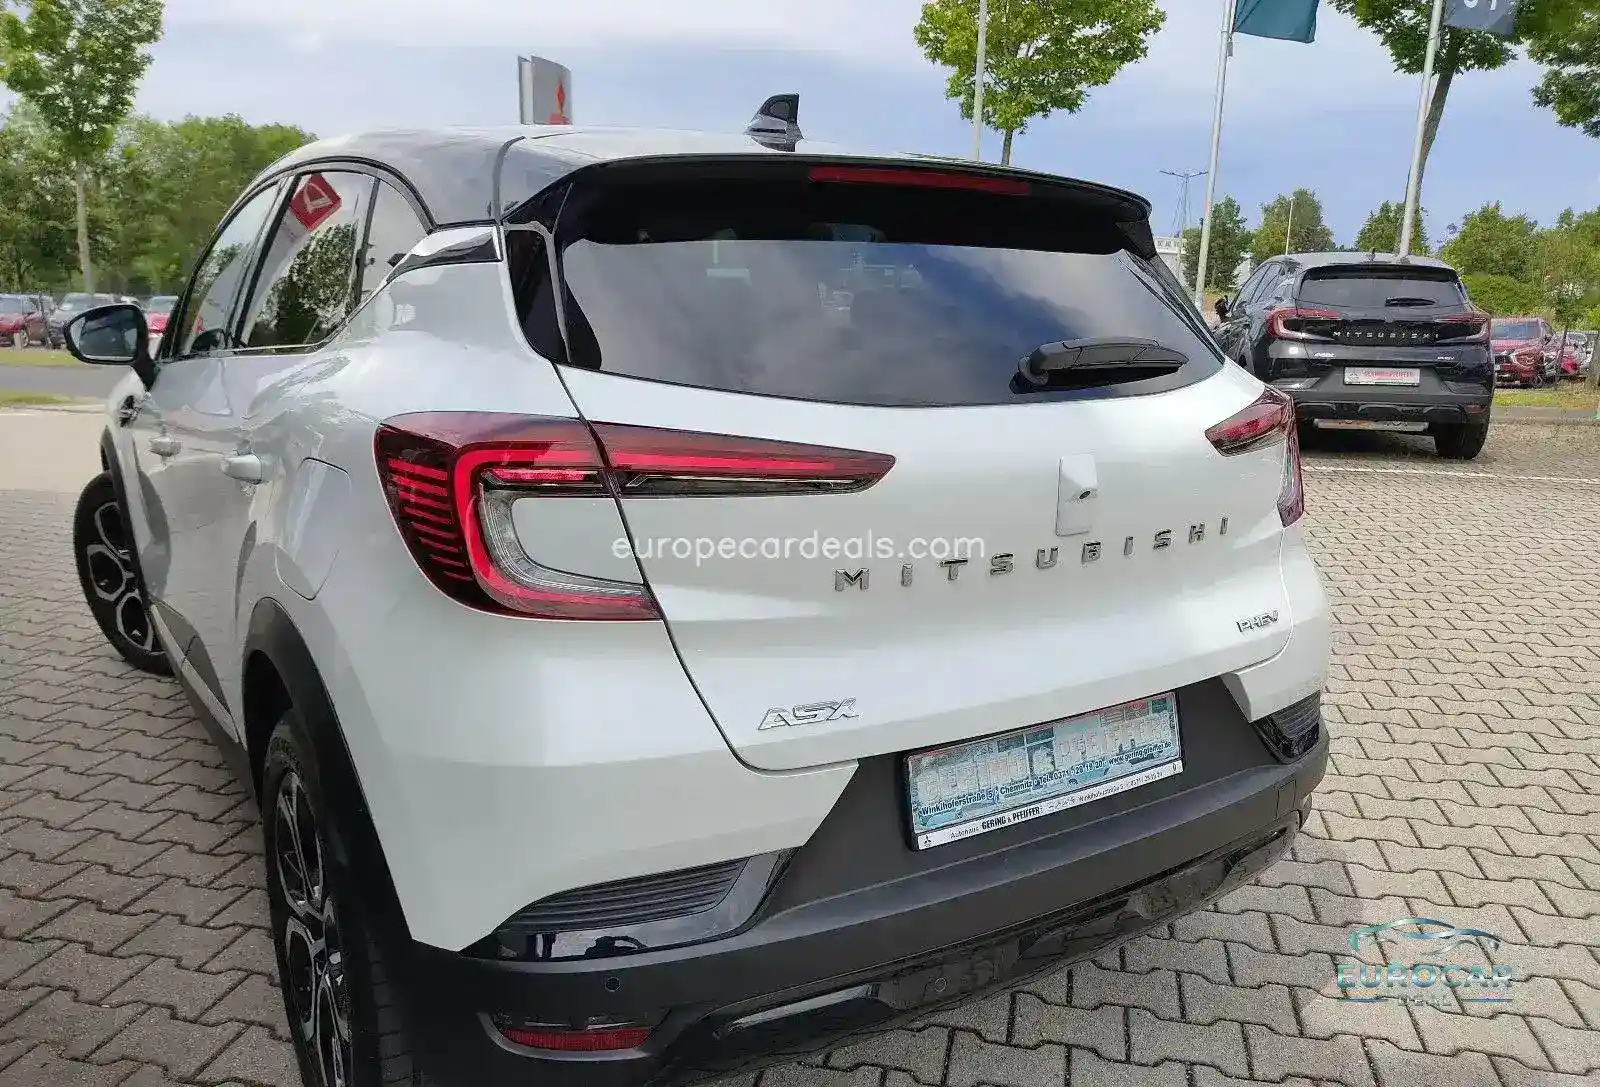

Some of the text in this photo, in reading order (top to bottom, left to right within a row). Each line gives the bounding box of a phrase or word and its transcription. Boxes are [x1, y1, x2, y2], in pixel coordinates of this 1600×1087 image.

[1333, 330, 1440, 339] MITSUBISHI
[834, 516, 1229, 592] MITSUBISHI
[1237, 609, 1279, 633] PHEV
[758, 697, 860, 731] ASX
[1000, 780, 1032, 795] Chemnitz
[982, 816, 1006, 830] GERING
[1013, 806, 1041, 822] PFEIFFER
